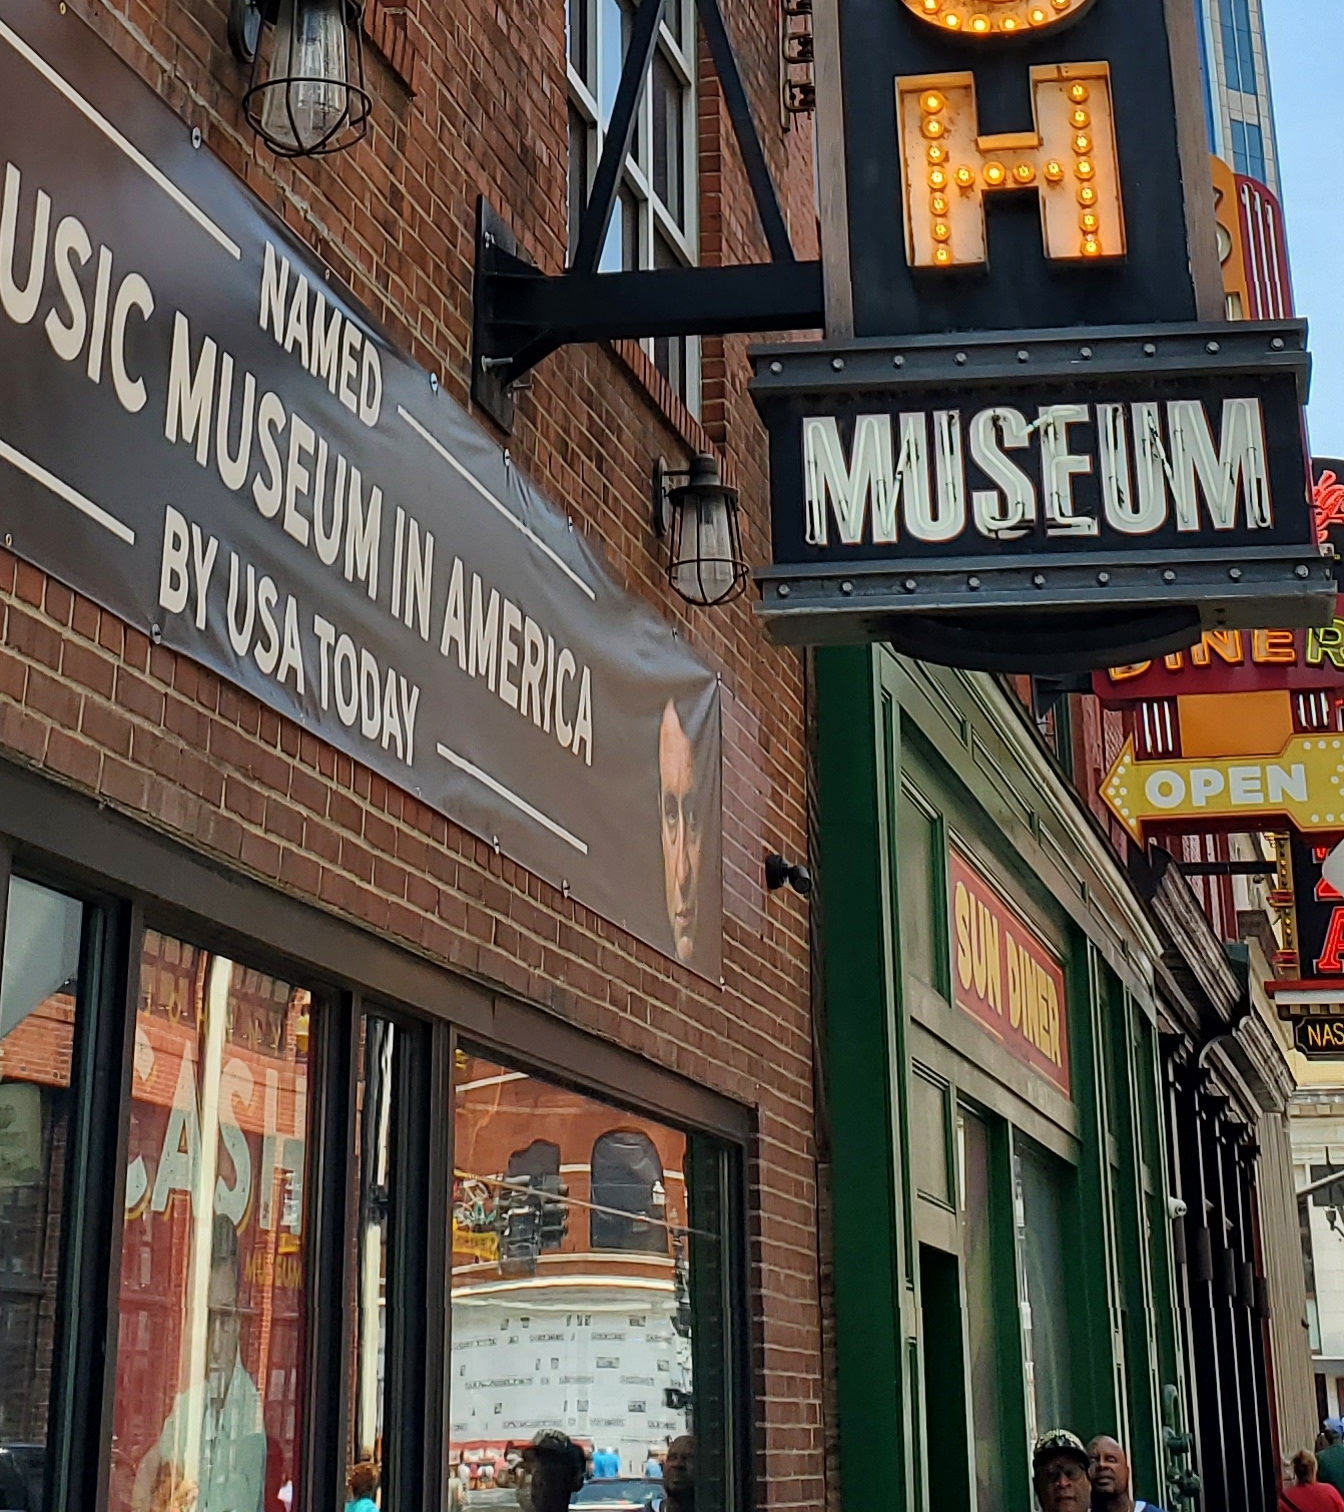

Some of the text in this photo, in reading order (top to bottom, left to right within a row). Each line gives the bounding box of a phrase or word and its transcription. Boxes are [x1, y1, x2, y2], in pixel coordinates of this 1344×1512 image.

[260, 240, 383, 428] NAMED
[164, 310, 385, 606] MUSEUM
[393, 505, 434, 640] IN
[441, 557, 594, 765] AMERICA
[802, 397, 1273, 546] MUSEUM
[159, 503, 419, 766] BY USA TODAY
[1145, 763, 1308, 809] OPEN
[955, 881, 1062, 1068] SUN DINER
